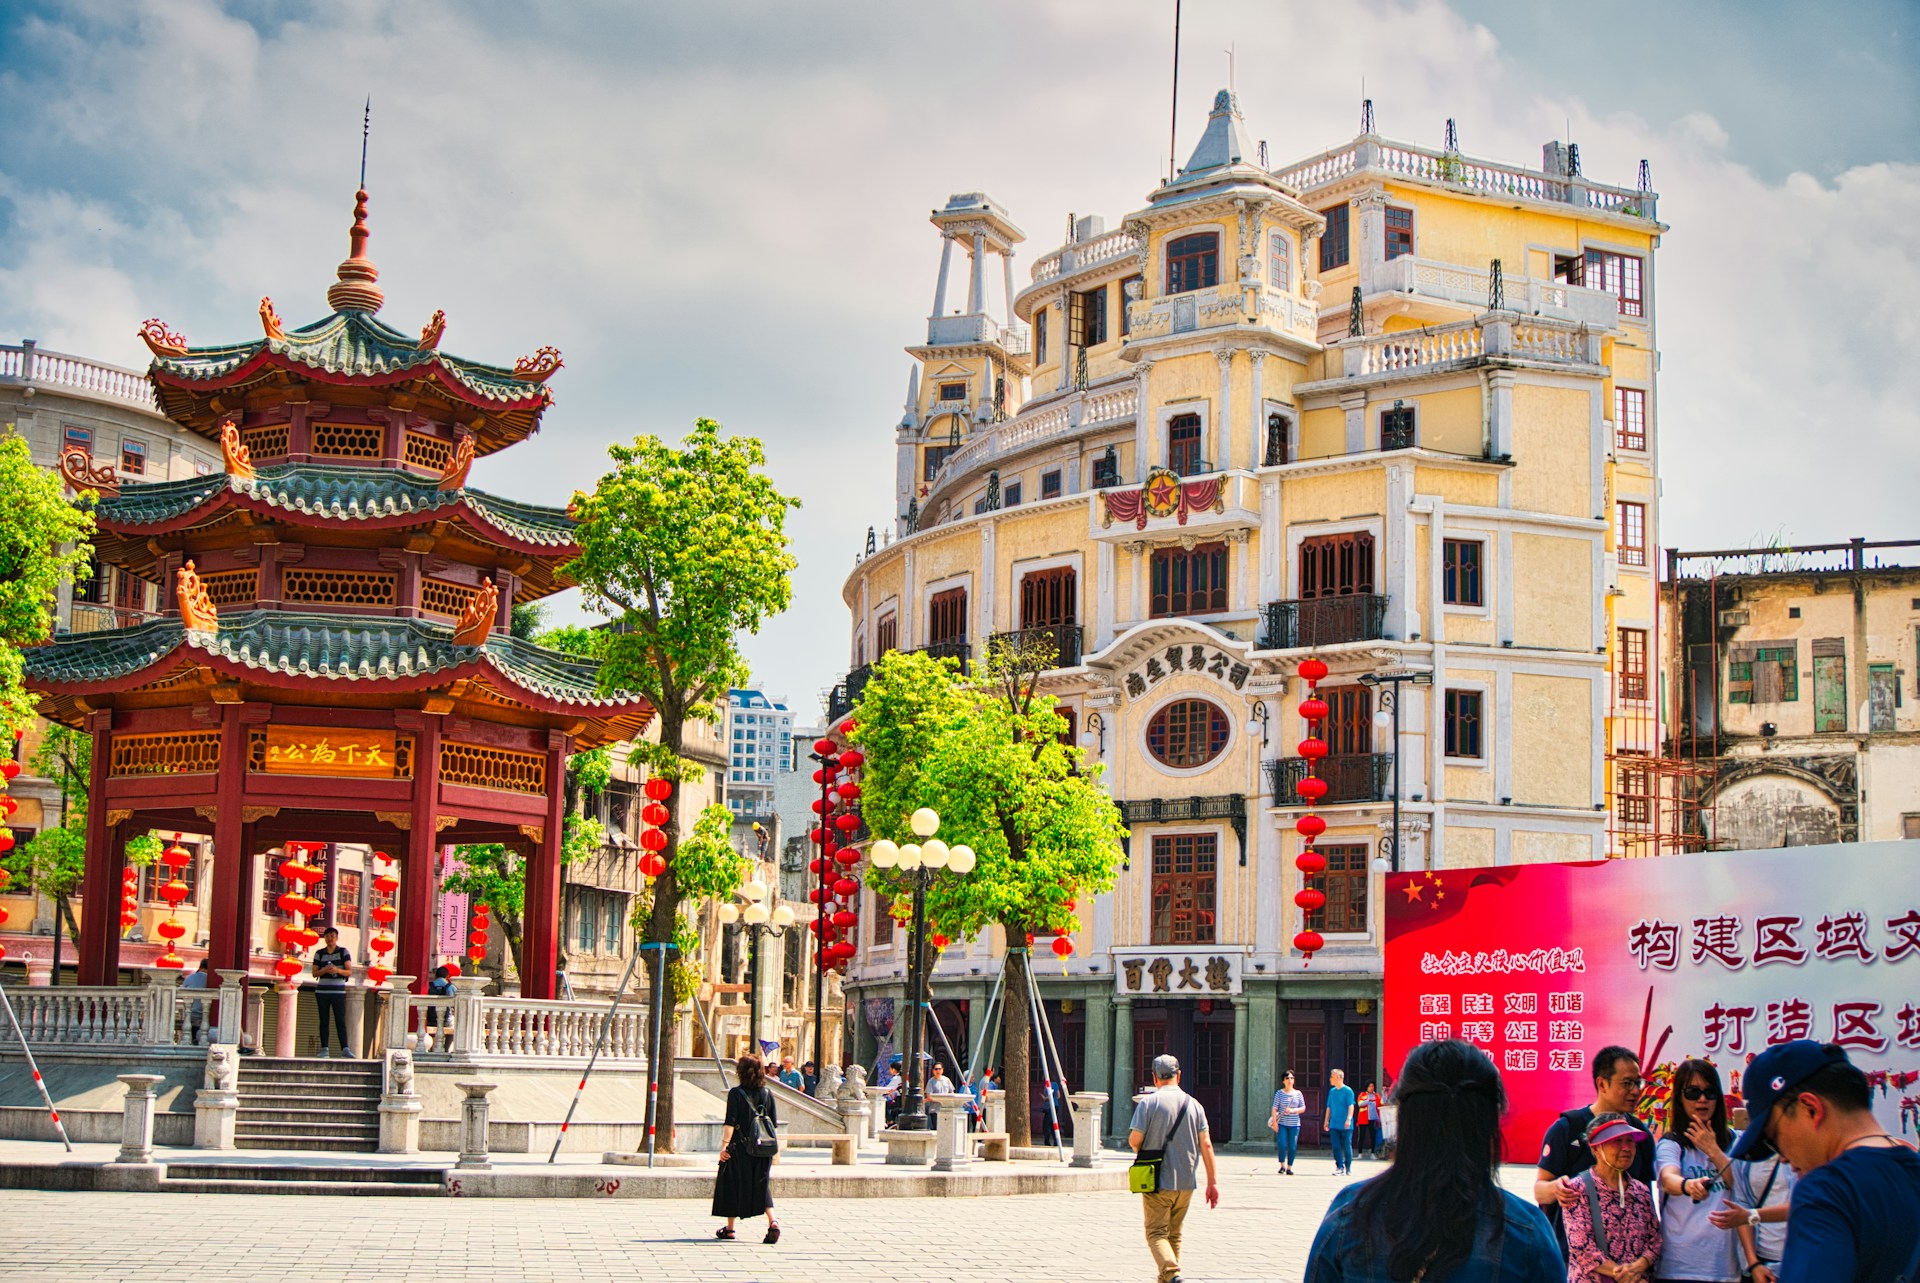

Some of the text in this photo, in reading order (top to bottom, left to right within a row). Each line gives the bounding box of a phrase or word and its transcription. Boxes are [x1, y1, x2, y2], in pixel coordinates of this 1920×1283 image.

[1126, 645, 1250, 698] 南生貿易公司
[449, 905, 459, 941] FION
[1629, 909, 1920, 970] 构建区域文
[1122, 956, 1232, 992] 百貨大樓
[1421, 947, 1586, 975] 社会主义核心价值观
[1420, 992, 1584, 1014] 富强 民主 文明 和谐
[1420, 1021, 1584, 1042] 自由 平等 公正 法治
[1504, 1050, 1538, 1071] 诚信
[1549, 1050, 1584, 1071] 友善
